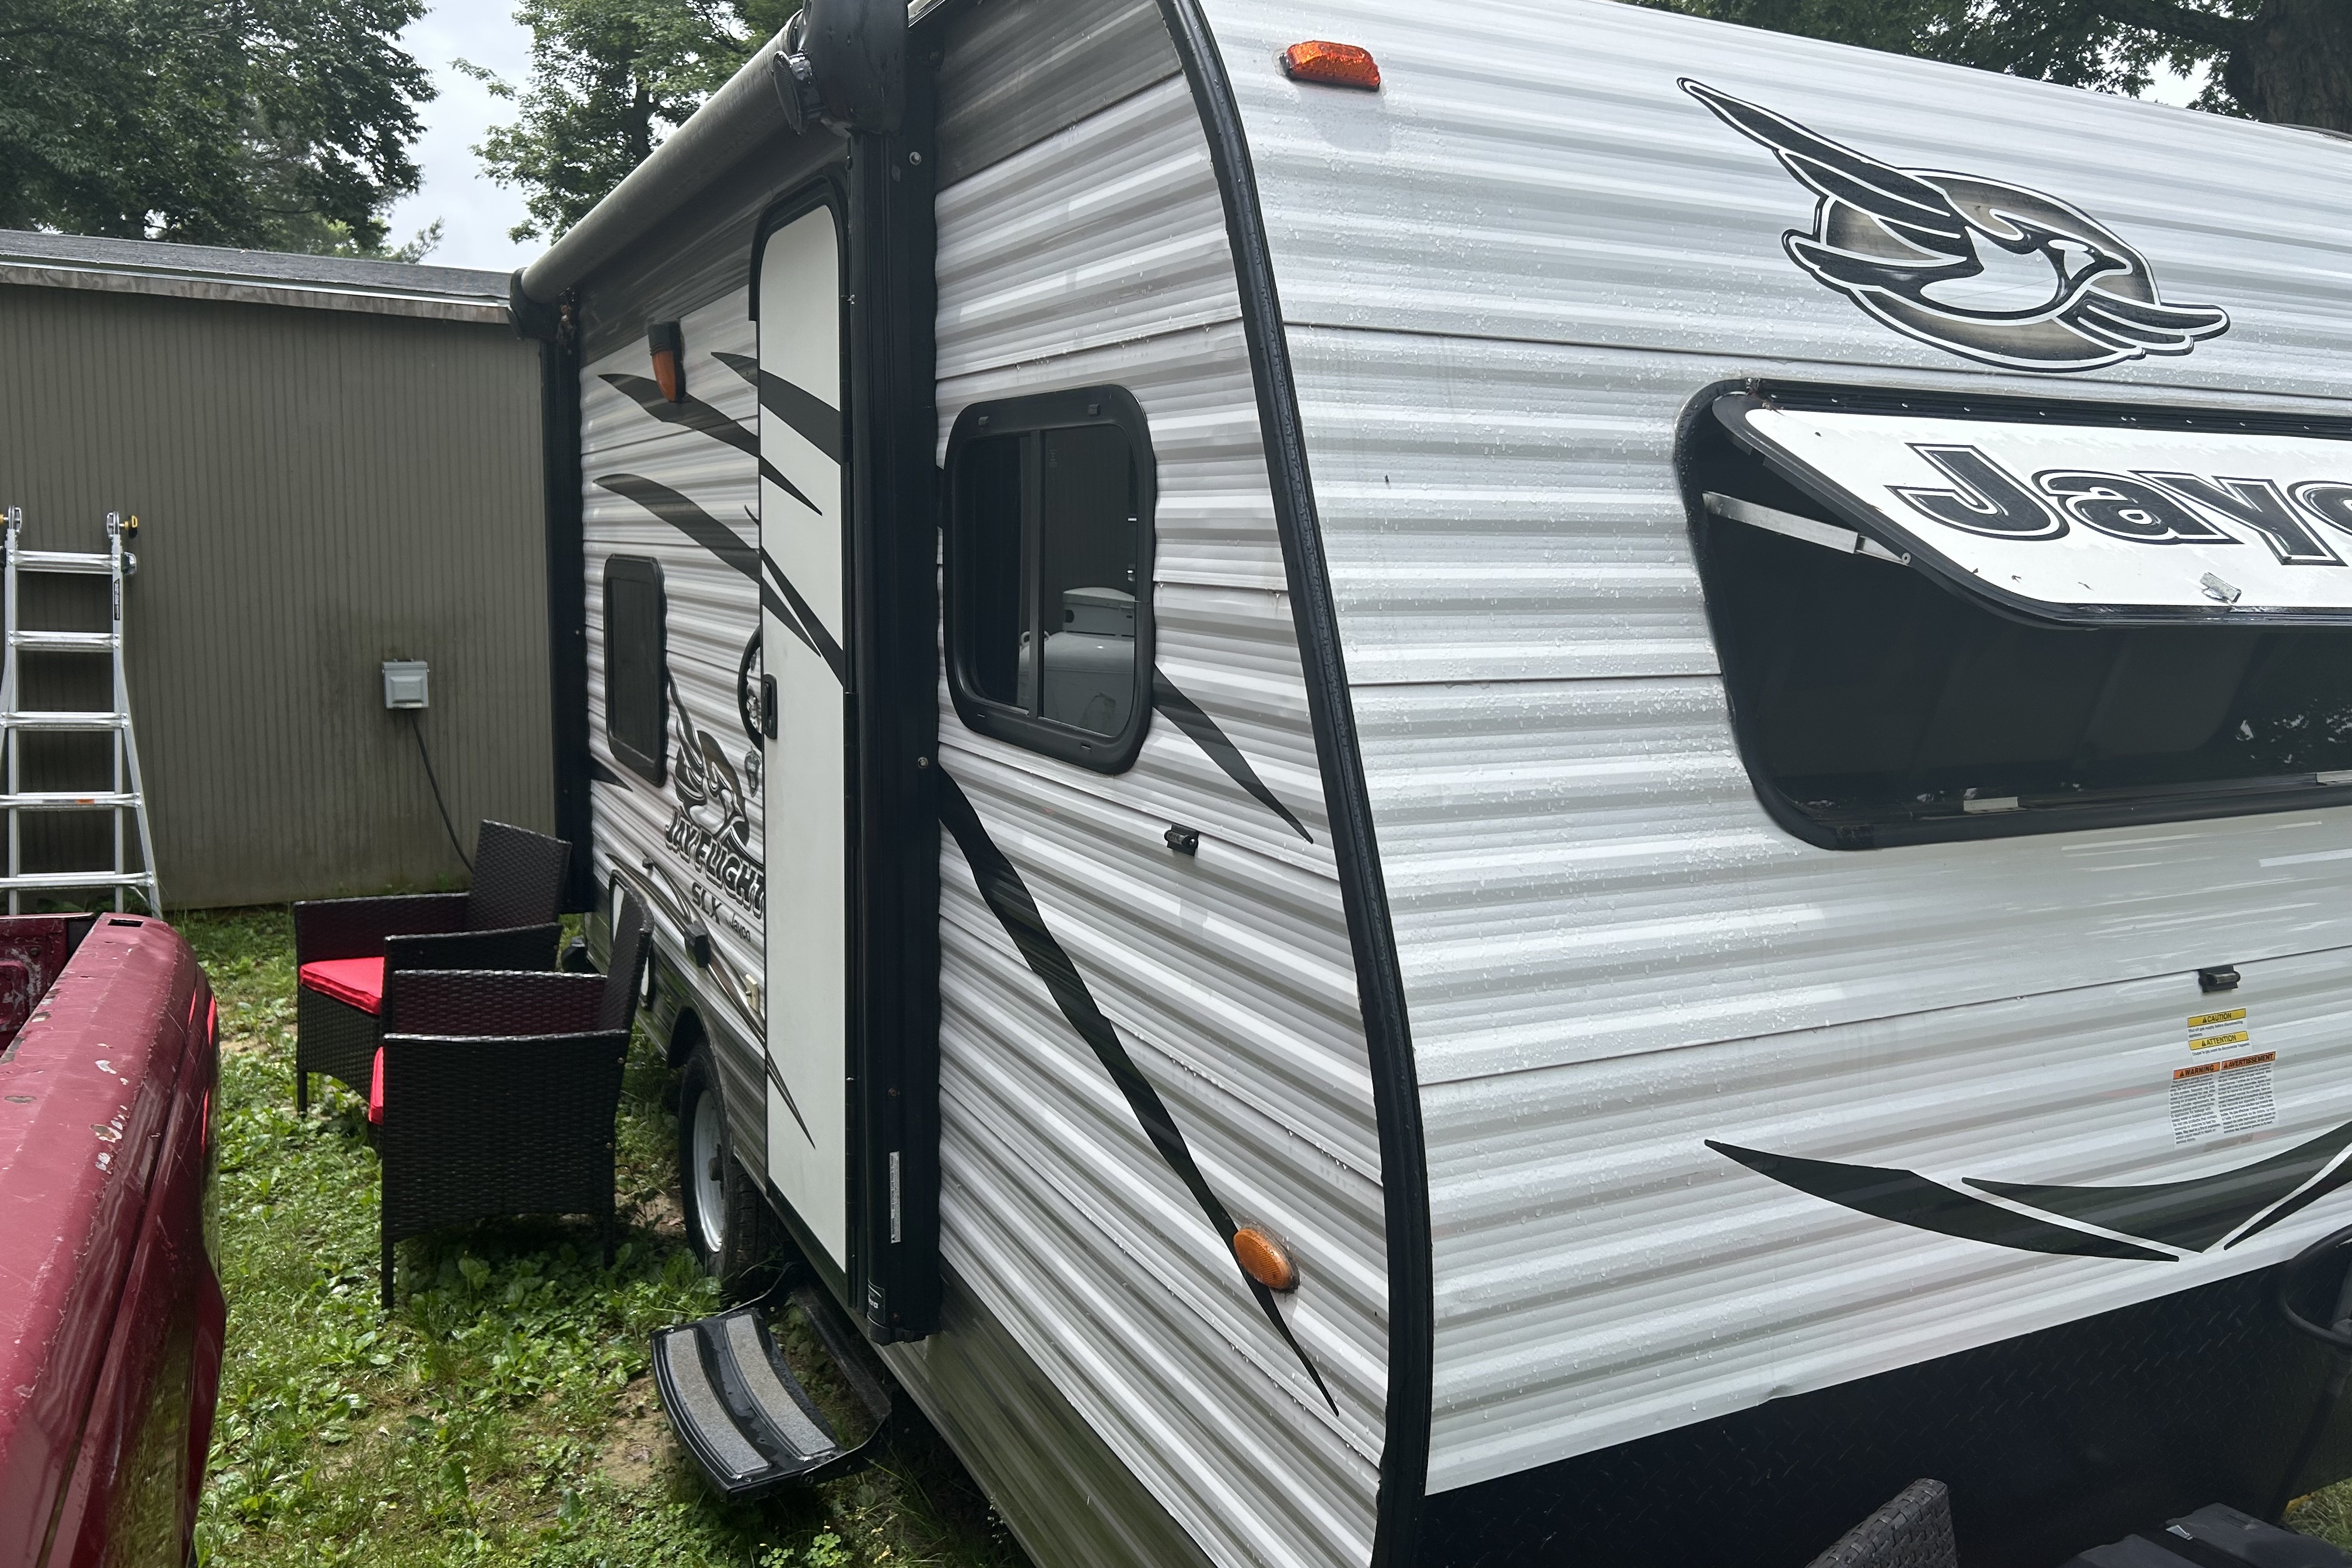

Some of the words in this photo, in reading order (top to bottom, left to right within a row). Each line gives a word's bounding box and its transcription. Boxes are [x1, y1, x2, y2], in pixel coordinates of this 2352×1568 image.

[665, 804, 700, 864] JAY
[694, 827, 764, 920] FLIGHT
[692, 881, 722, 925] SLX
[729, 912, 751, 943] Jayco
[2207, 1012, 2232, 1023] CAUTION
[2206, 1033, 2236, 1045] ATTENTION
[2228, 1053, 2274, 1067] AVERTISSEMENT
[2185, 1065, 2214, 1076] WARNING
